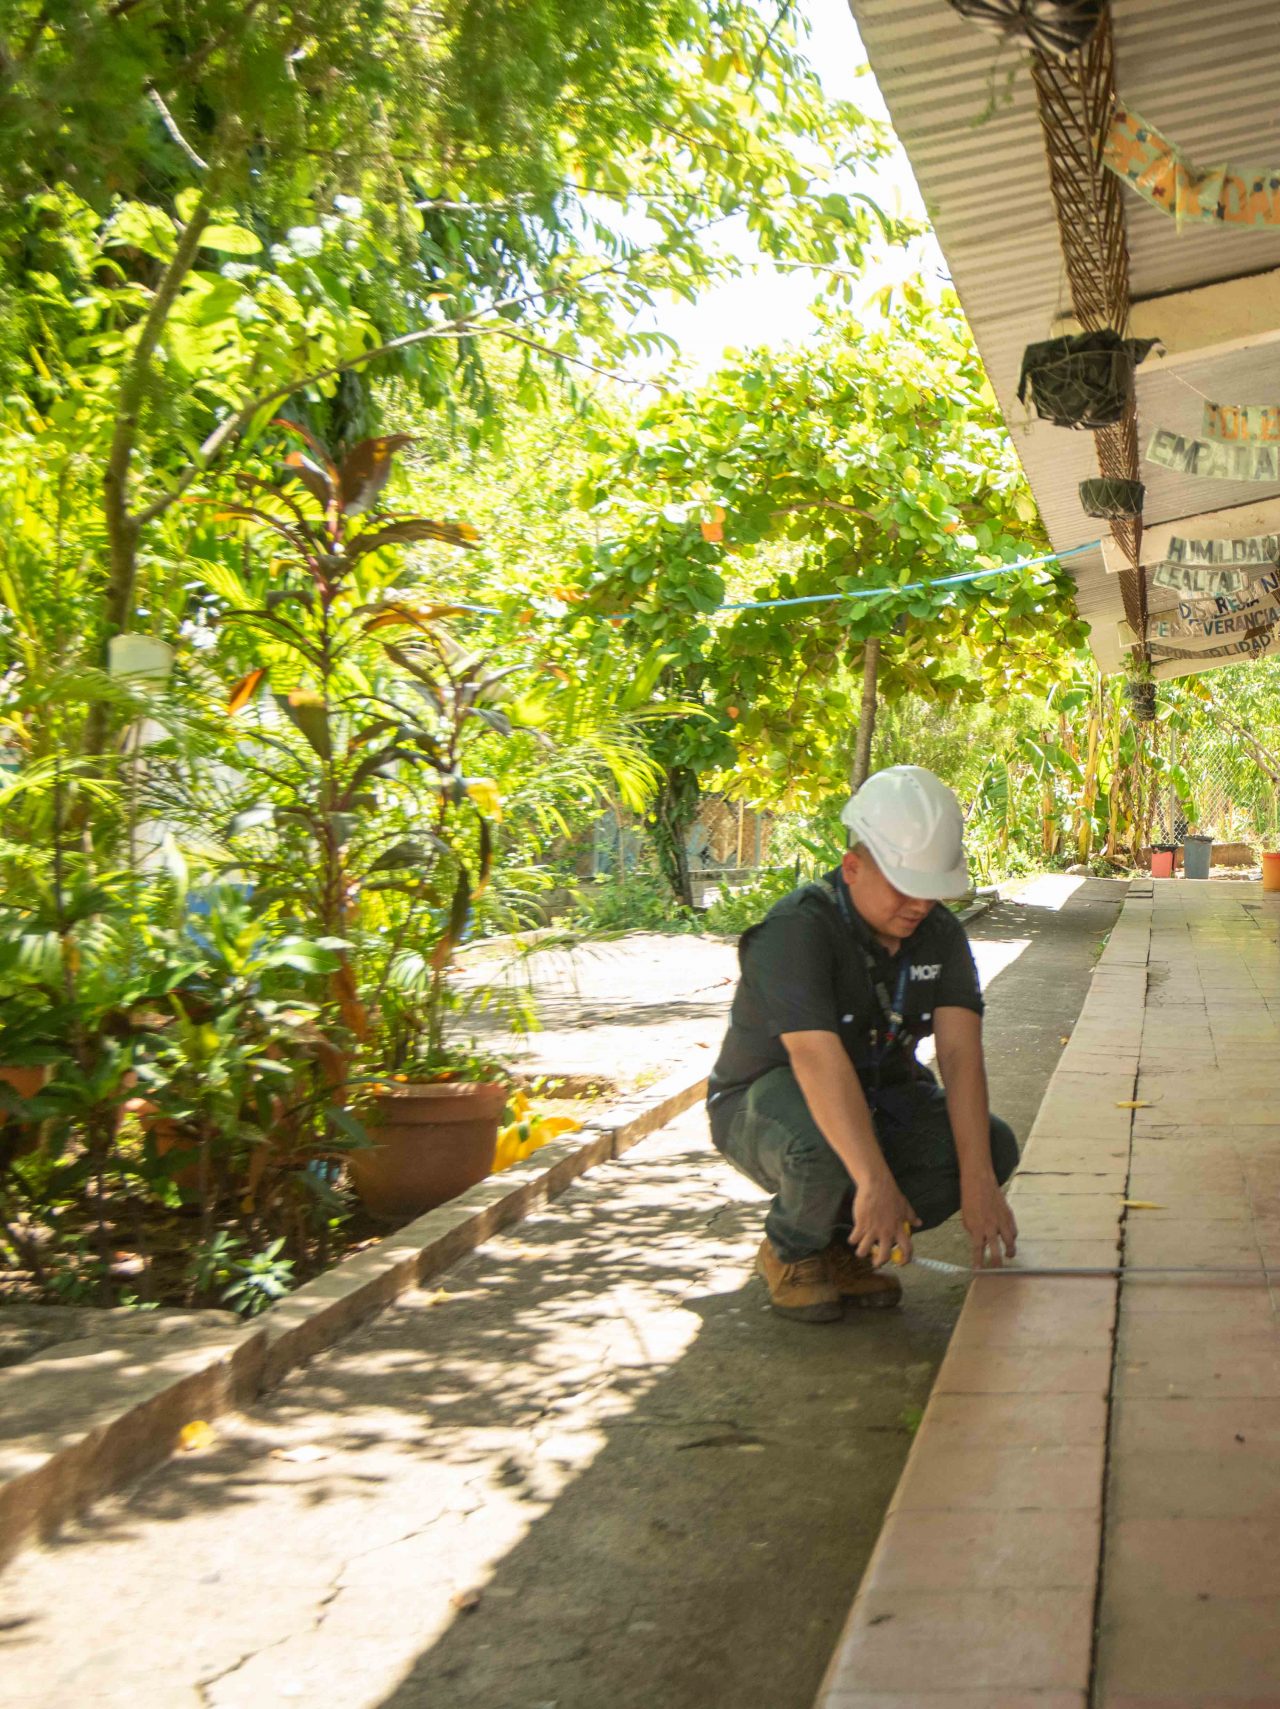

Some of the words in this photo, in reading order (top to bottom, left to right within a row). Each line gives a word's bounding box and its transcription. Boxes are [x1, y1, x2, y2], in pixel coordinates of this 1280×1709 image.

[1168, 537, 1278, 562] HUMILDAD
[1156, 564, 1242, 592] LEALTAD
[1149, 634, 1271, 659] ESPONSABILIDAD
